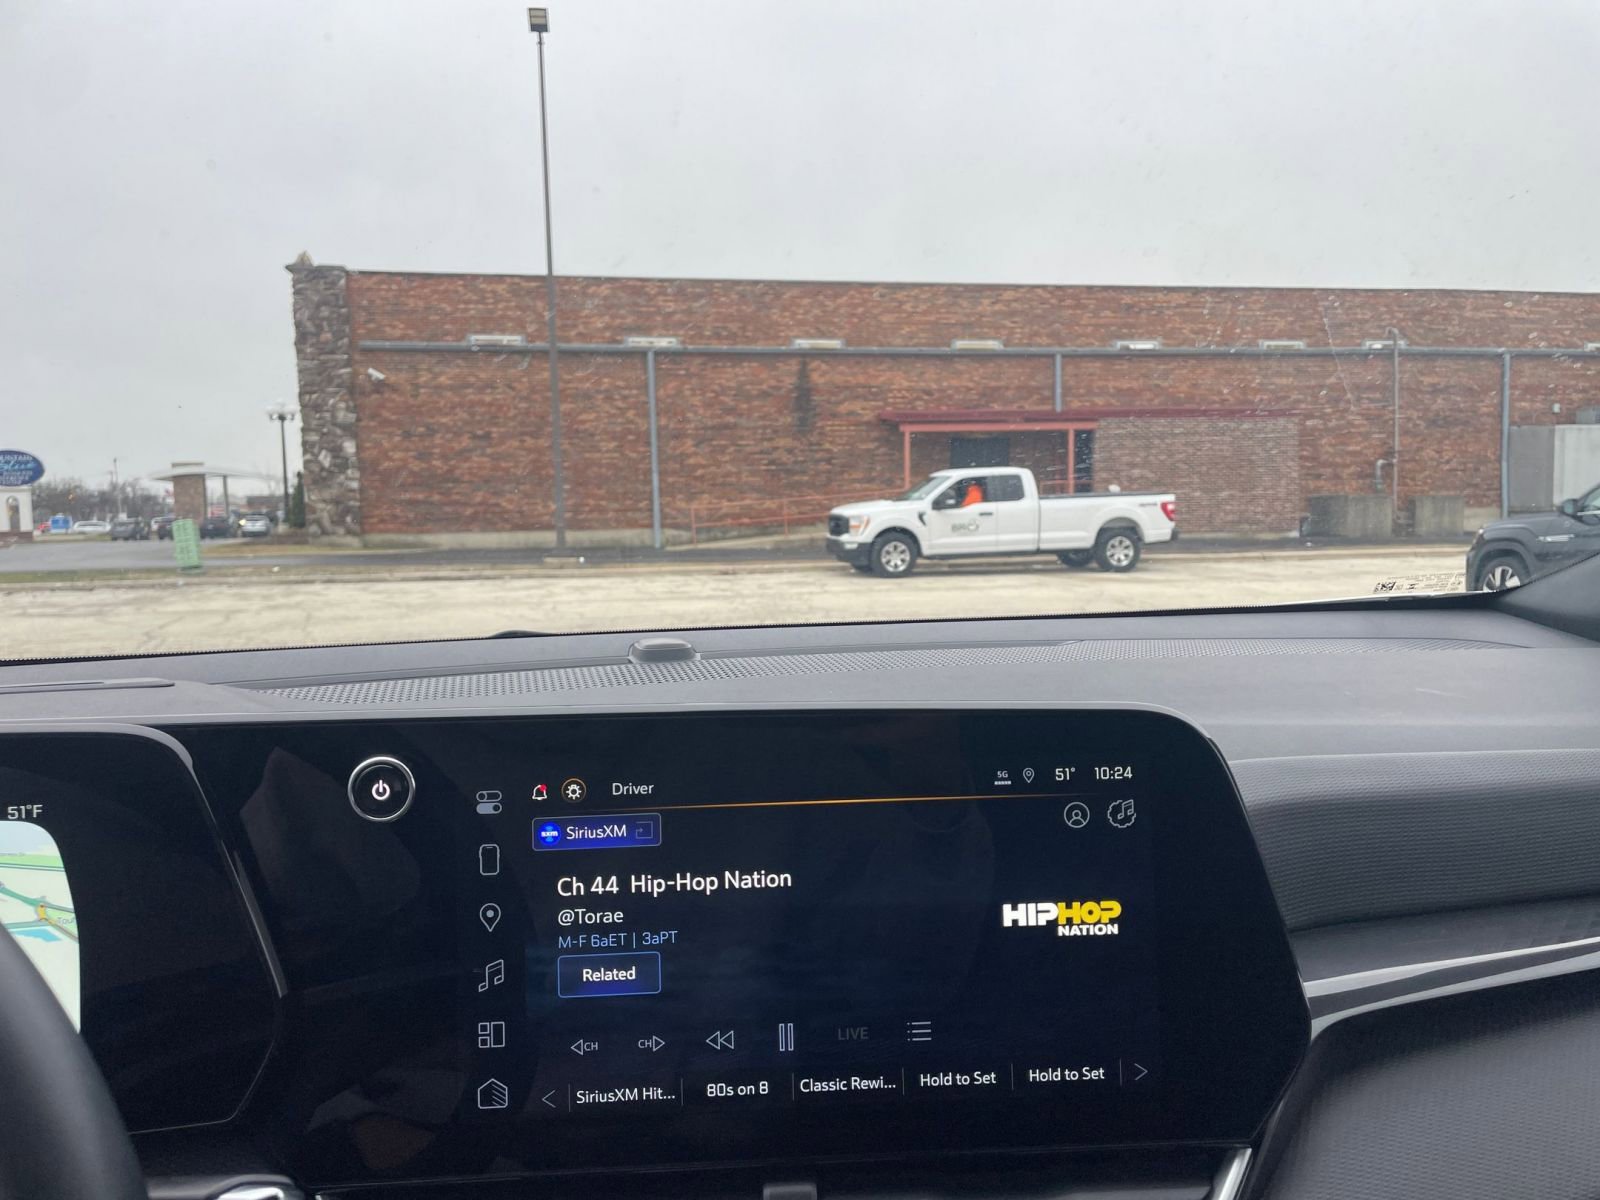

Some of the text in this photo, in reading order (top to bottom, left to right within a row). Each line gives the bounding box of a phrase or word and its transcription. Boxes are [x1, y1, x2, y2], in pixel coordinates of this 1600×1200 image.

[997, 770, 1009, 779] 5G
[1054, 766, 1076, 781] 51°
[1094, 766, 1133, 780] 10:24
[612, 782, 655, 796] Driver
[7, 804, 43, 820] 51°F
[566, 824, 627, 840] SiriusXM
[557, 869, 792, 898] Ch 44 Hip-Hop Nation
[557, 908, 624, 926] @Torae
[1057, 923, 1119, 937] NATION
[558, 934, 587, 949] M-F
[591, 932, 627, 948] 6aET
[642, 930, 678, 945] 3aPT
[582, 965, 636, 982] Related
[837, 1026, 869, 1041] LIVE
[583, 1041, 599, 1052] CH
[638, 1039, 652, 1049] CH
[920, 1071, 997, 1087] Hold to Set
[1029, 1066, 1105, 1082] Hold to Set
[706, 1080, 769, 1097] 80s on 8
[800, 1077, 848, 1093] Classic
[576, 1087, 639, 1104] SiriusXM
